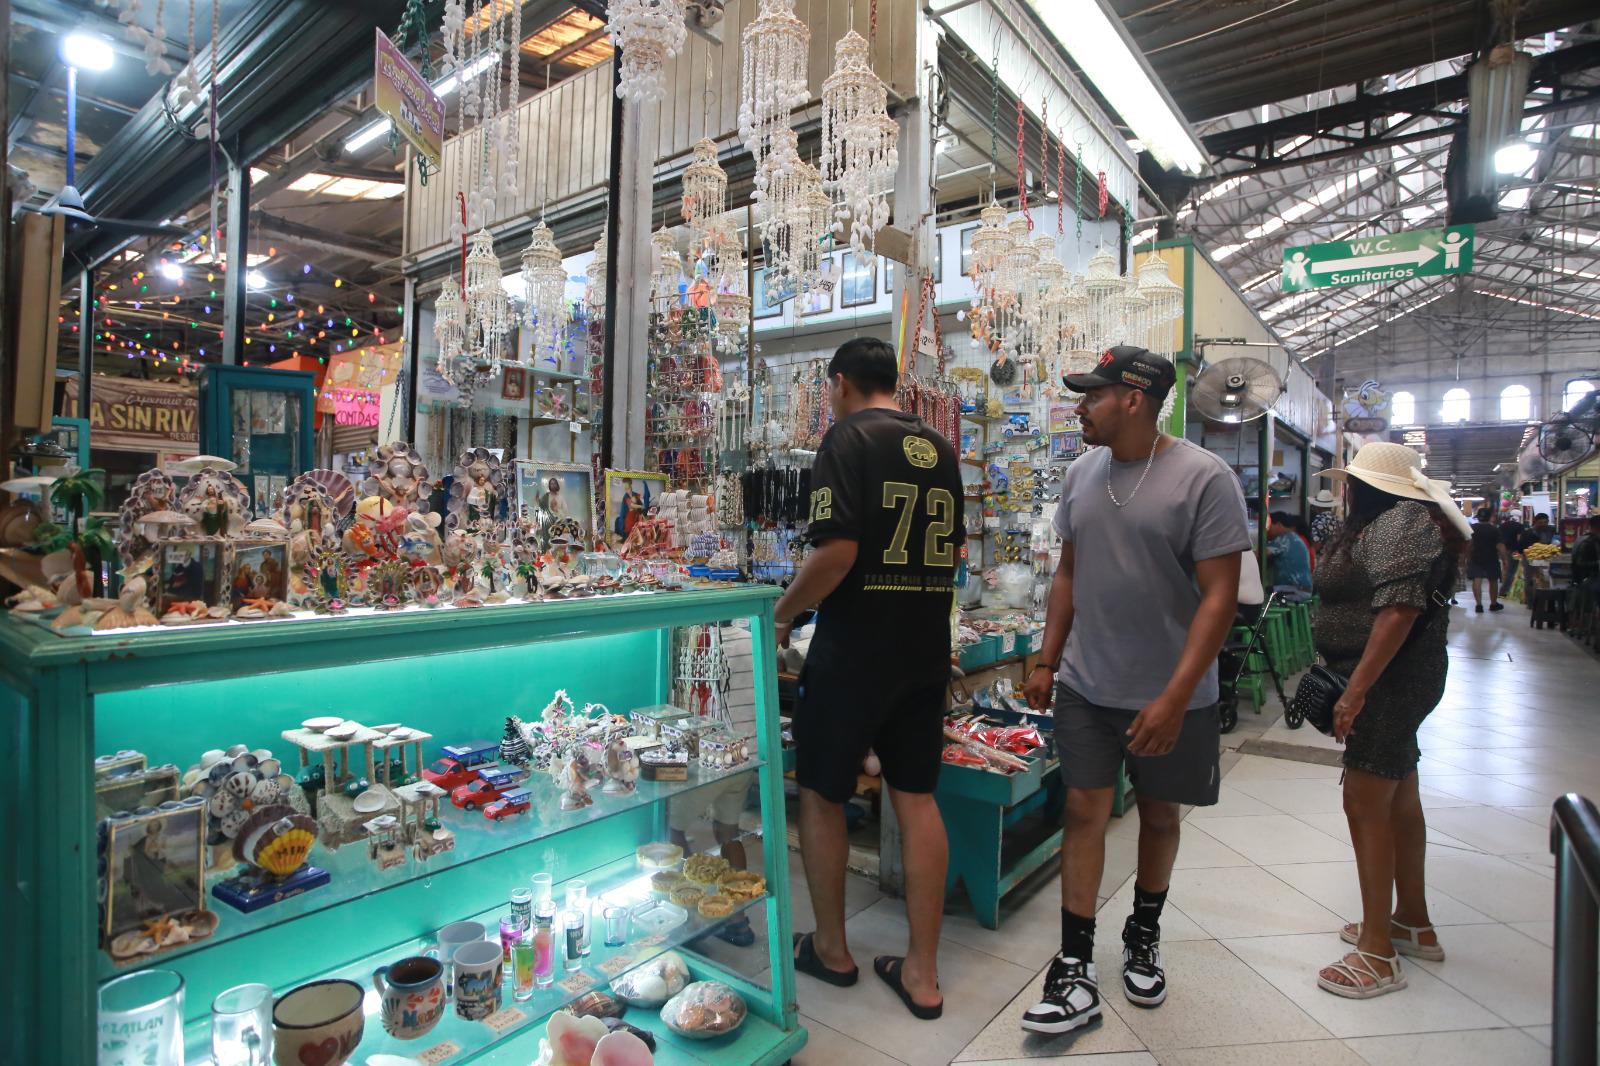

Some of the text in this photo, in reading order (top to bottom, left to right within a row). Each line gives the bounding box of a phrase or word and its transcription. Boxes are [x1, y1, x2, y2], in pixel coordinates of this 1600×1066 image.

[1349, 239, 1396, 256] W.C.
[1330, 267, 1414, 285] Sanitarios
[110, 403, 152, 431] SIN
[335, 410, 380, 428] COMIDAS
[882, 481, 955, 567] 72
